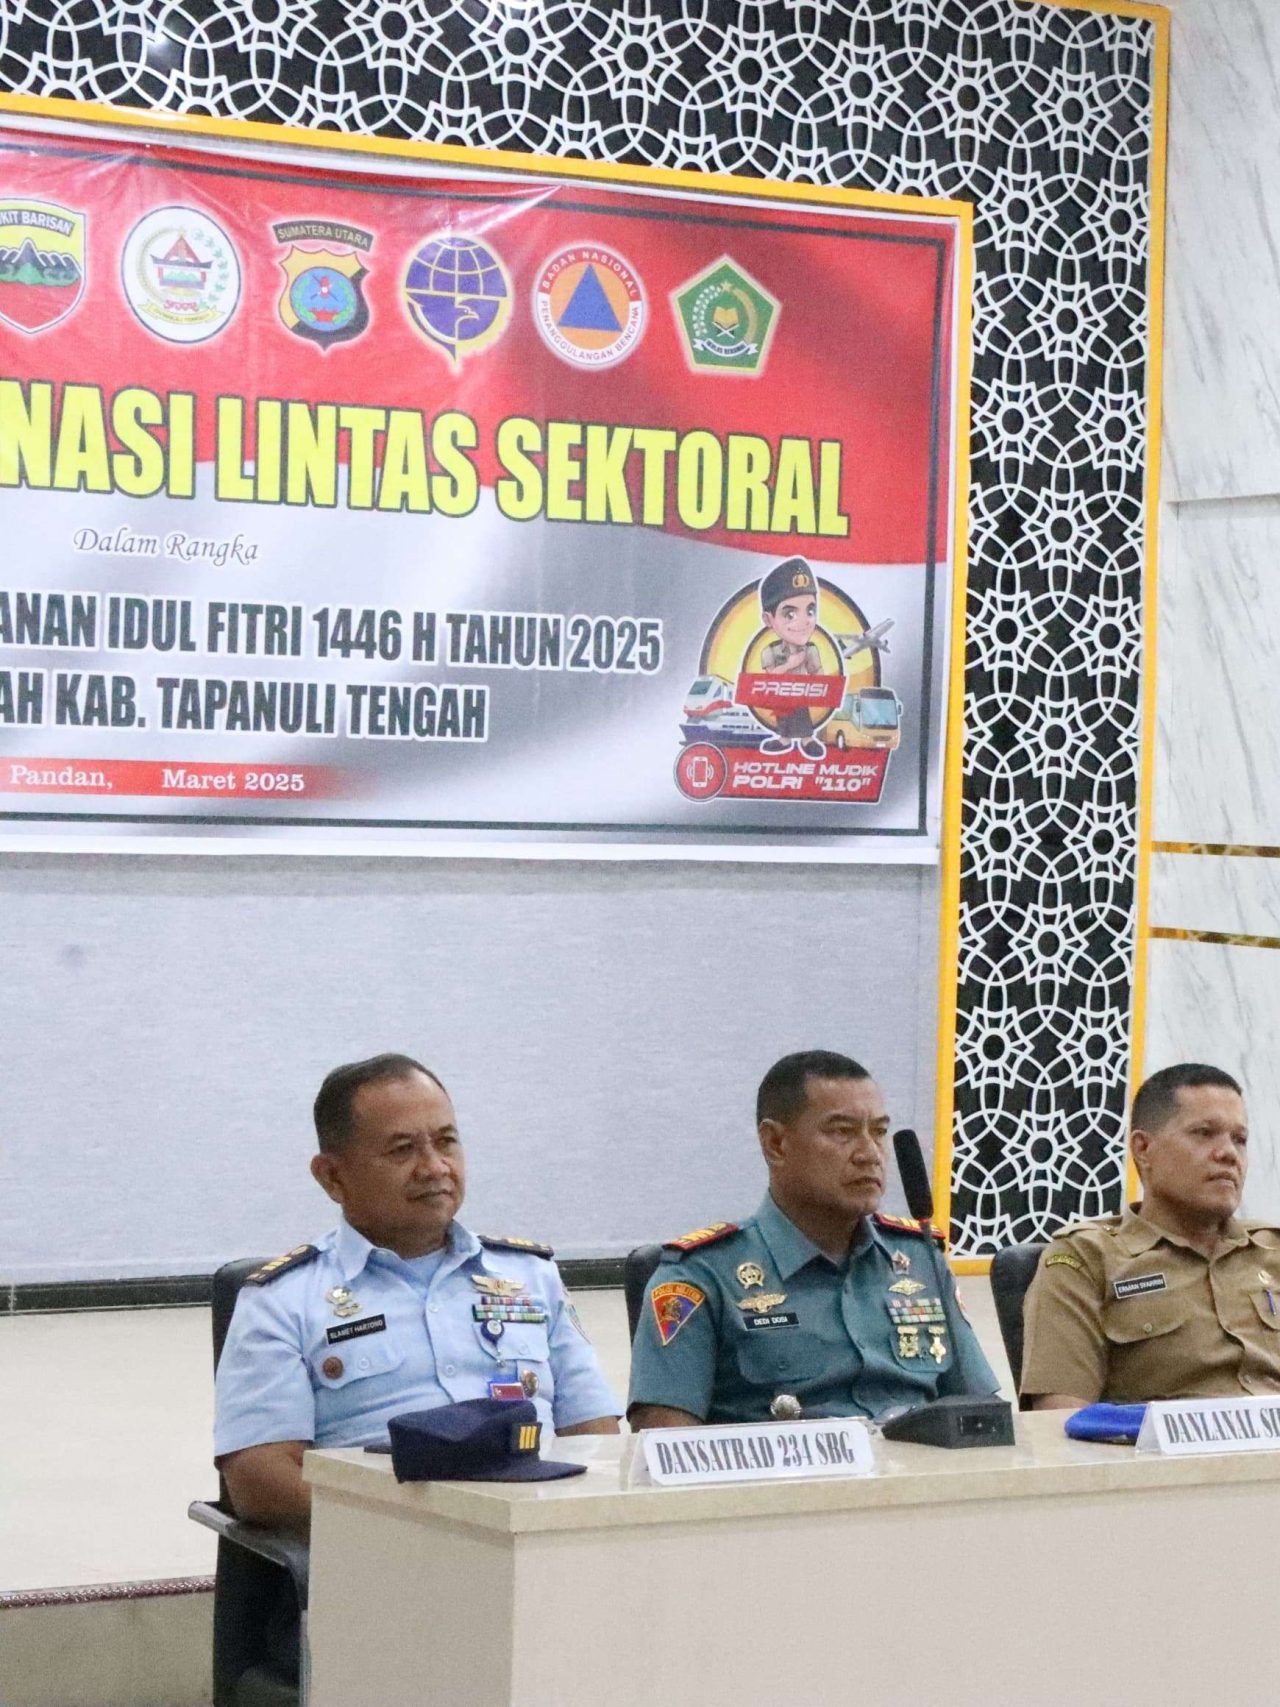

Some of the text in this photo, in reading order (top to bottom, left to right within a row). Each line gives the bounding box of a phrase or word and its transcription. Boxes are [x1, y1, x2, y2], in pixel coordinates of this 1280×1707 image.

[22, 211, 73, 235] BARISAN
[277, 225, 368, 247] SUMATERA UTARA
[542, 251, 637, 297] BADAN NASIONAL
[541, 300, 639, 360] PENANGGULANGAN BENCANA
[0, 377, 850, 538] NASI LINTAS SEKTORAL
[73, 527, 259, 566] Dalam Rangka
[108, 596, 196, 652] IDUL
[207, 602, 302, 656] FITRI
[312, 607, 402, 661] 1446
[413, 611, 436, 663] H
[446, 613, 560, 667] TAHUN
[570, 619, 660, 670] 2025
[56, 673, 146, 728] KAB.
[156, 677, 336, 734] TAPANULI
[346, 684, 486, 738] TENGAH
[751, 681, 829, 697] PRESISI
[10, 765, 304, 792] Pandan, Maret 2025
[733, 762, 879, 776] HOTLINE MUDIK
[733, 775, 871, 791] POLRI "110"
[1162, 1409, 1261, 1444] DANLANAL
[655, 1431, 855, 1475] DANSATRAD 234 SBG
